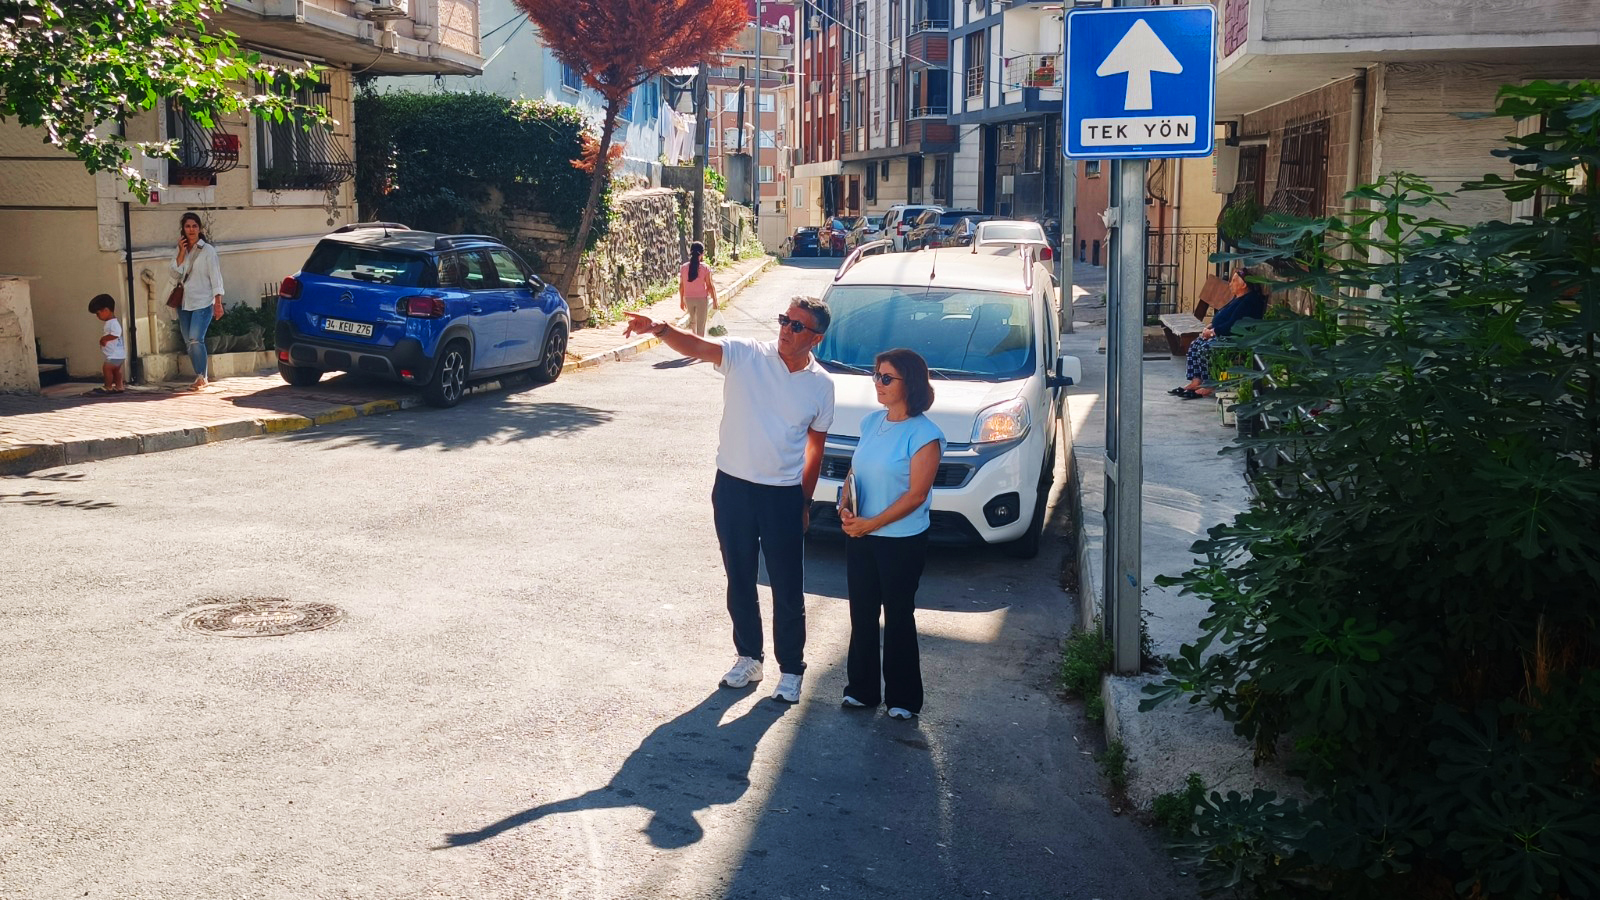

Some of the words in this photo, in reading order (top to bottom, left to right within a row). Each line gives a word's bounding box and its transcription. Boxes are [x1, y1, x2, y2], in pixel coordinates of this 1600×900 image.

[1088, 124, 1128, 139] TEK
[1144, 120, 1188, 138] YÖN
[326, 319, 335, 329] 34
[338, 321, 354, 332] KEU
[356, 324, 371, 335] 276
